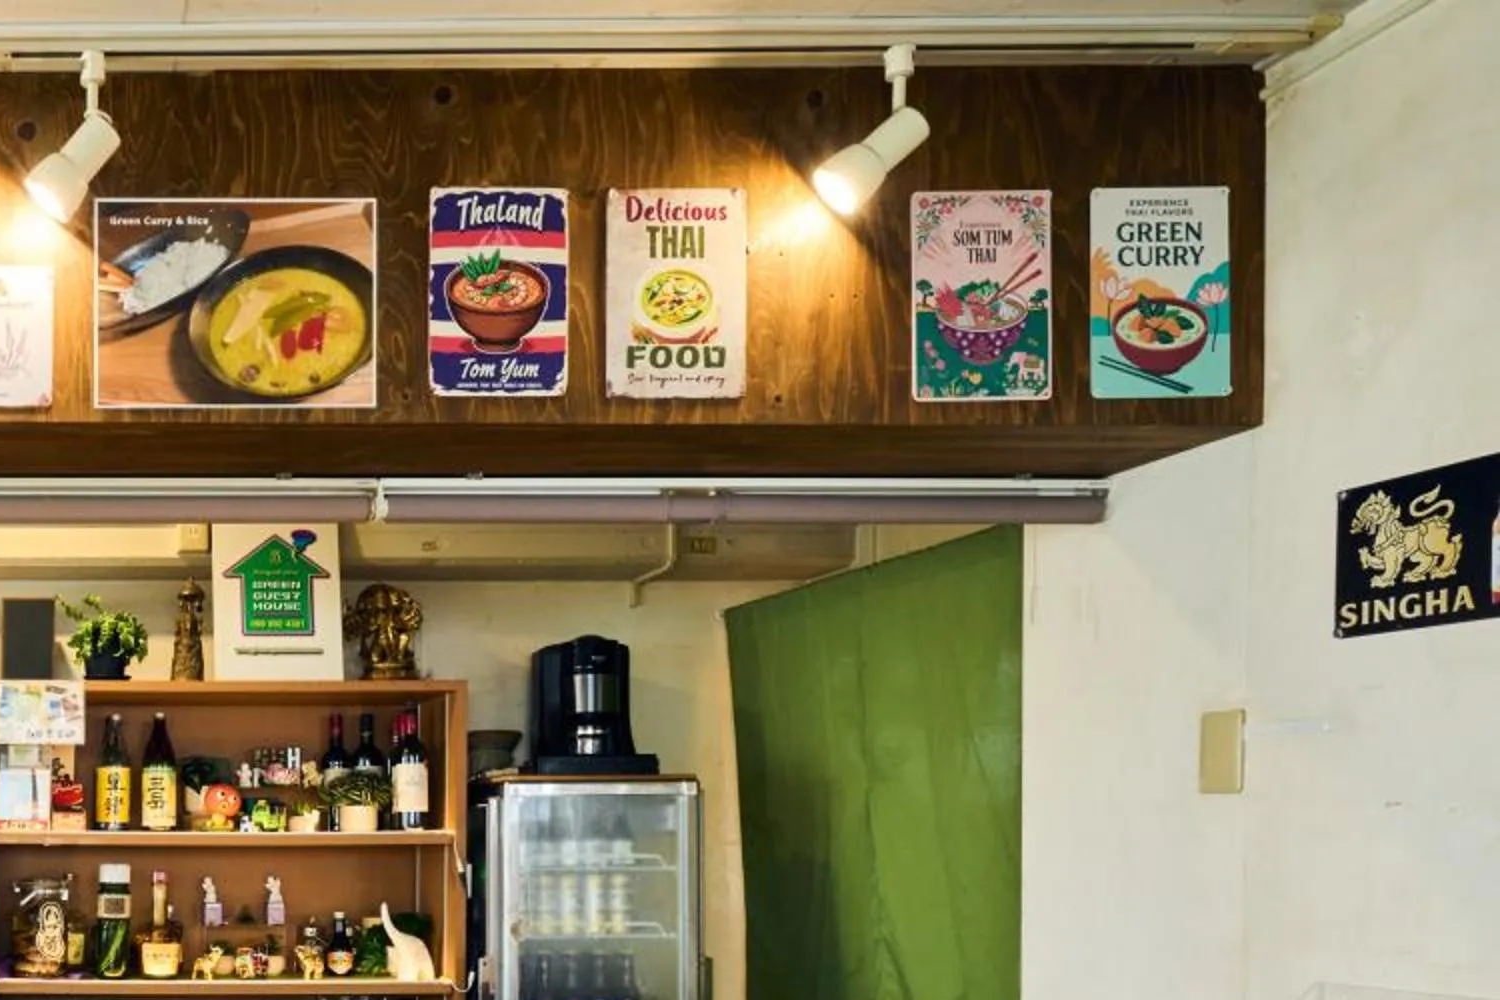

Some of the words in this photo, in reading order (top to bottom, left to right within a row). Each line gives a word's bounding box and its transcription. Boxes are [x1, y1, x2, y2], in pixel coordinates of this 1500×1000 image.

[626, 195, 728, 222] Delicious
[646, 226, 705, 259] THAI
[953, 230, 981, 247] SOM
[981, 229, 1013, 247] TUM
[1116, 221, 1203, 243] GREEN
[966, 247, 997, 264] THAI
[1117, 245, 1205, 267] CURRY
[626, 345, 727, 369] FOOD
[460, 357, 497, 379] Tom
[499, 357, 540, 384] Yum
[1338, 585, 1476, 629] SINGHA
